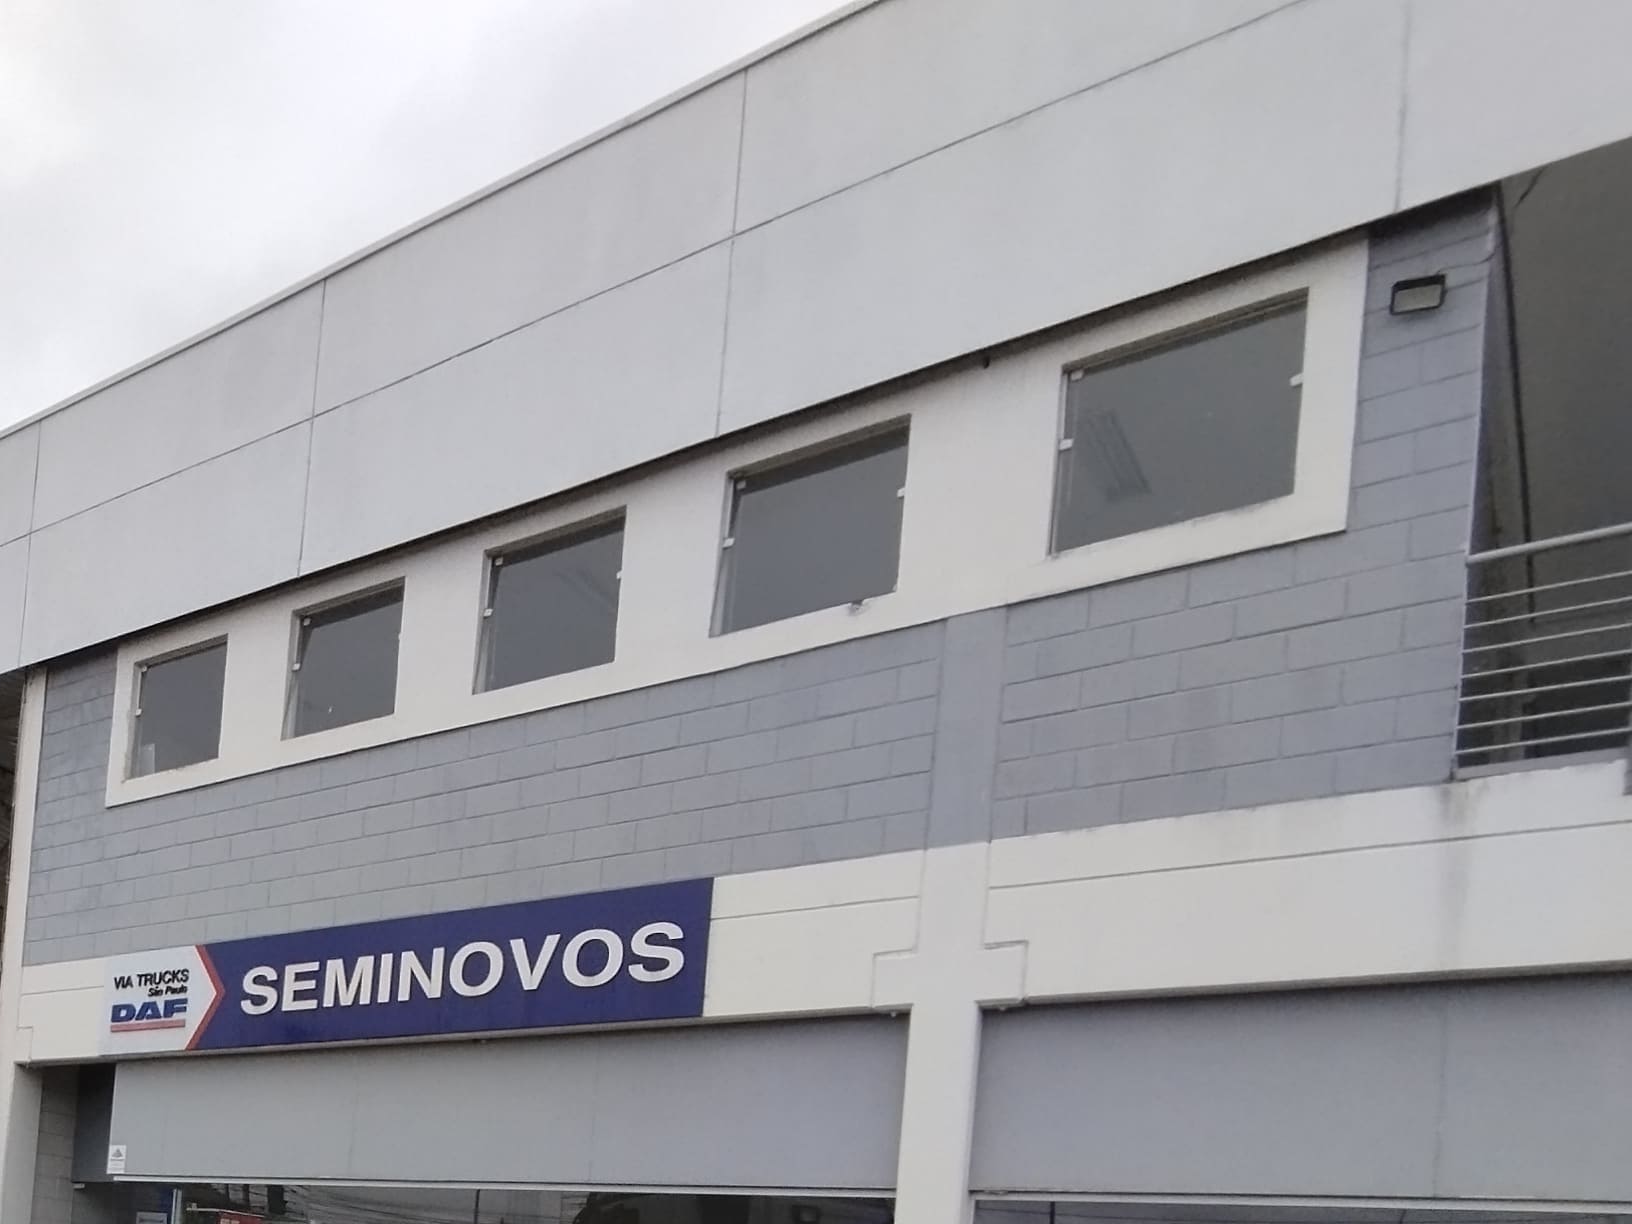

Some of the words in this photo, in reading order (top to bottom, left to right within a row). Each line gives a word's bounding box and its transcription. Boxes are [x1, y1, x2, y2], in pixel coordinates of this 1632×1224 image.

[114, 975, 134, 990] VIA
[136, 968, 190, 987] TRUCKS
[241, 920, 686, 1017] SEMINOVOS
[165, 984, 188, 996] Paulo
[111, 997, 188, 1023] DAF
